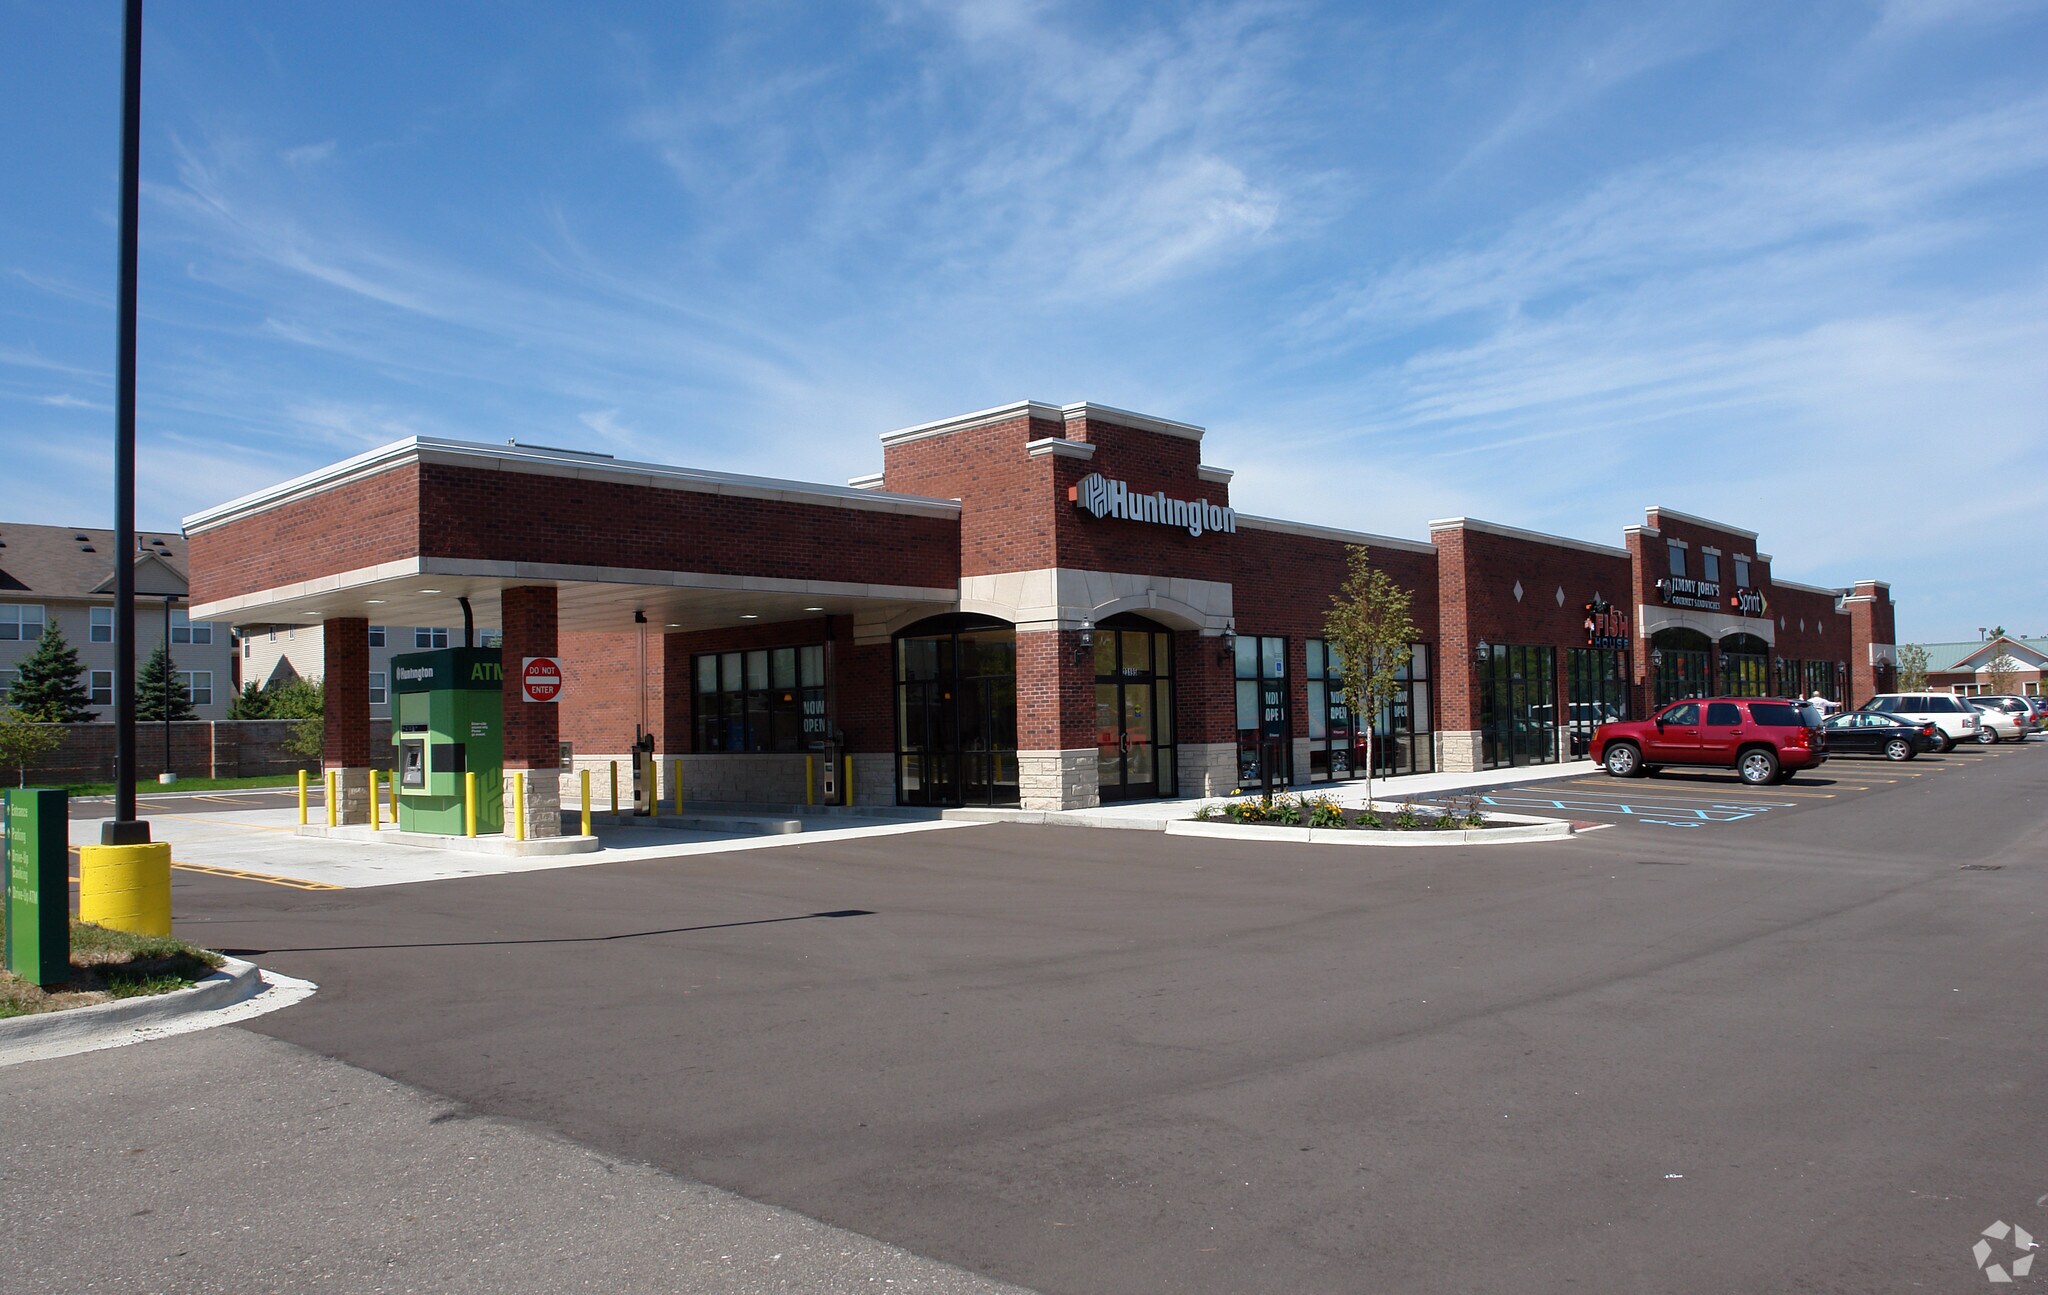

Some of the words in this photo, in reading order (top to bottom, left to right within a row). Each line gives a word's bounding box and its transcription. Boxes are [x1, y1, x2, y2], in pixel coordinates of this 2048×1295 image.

[1111, 479, 1236, 537] Huntington
[1672, 577, 1696, 593] JIMMY
[1697, 581, 1720, 597] JOHN'S
[1672, 595, 1694, 607] GOURMET
[1694, 598, 1720, 610] SANDWICHES
[1738, 588, 1760, 616] Sprint
[1595, 613, 1628, 637] FISH
[1595, 637, 1629, 649] HOUSE
[400, 667, 434, 681] Huntington
[529, 666, 539, 675] DO
[541, 666, 555, 675] NOT
[531, 686, 554, 694] ENTER
[803, 700, 825, 715] NOW
[1330, 706, 1347, 720] OPEN
[803, 718, 826, 733] OPEN
[11, 803, 28, 817] Entrance
[12, 827, 26, 844] Parking
[12, 865, 28, 883] Banking
